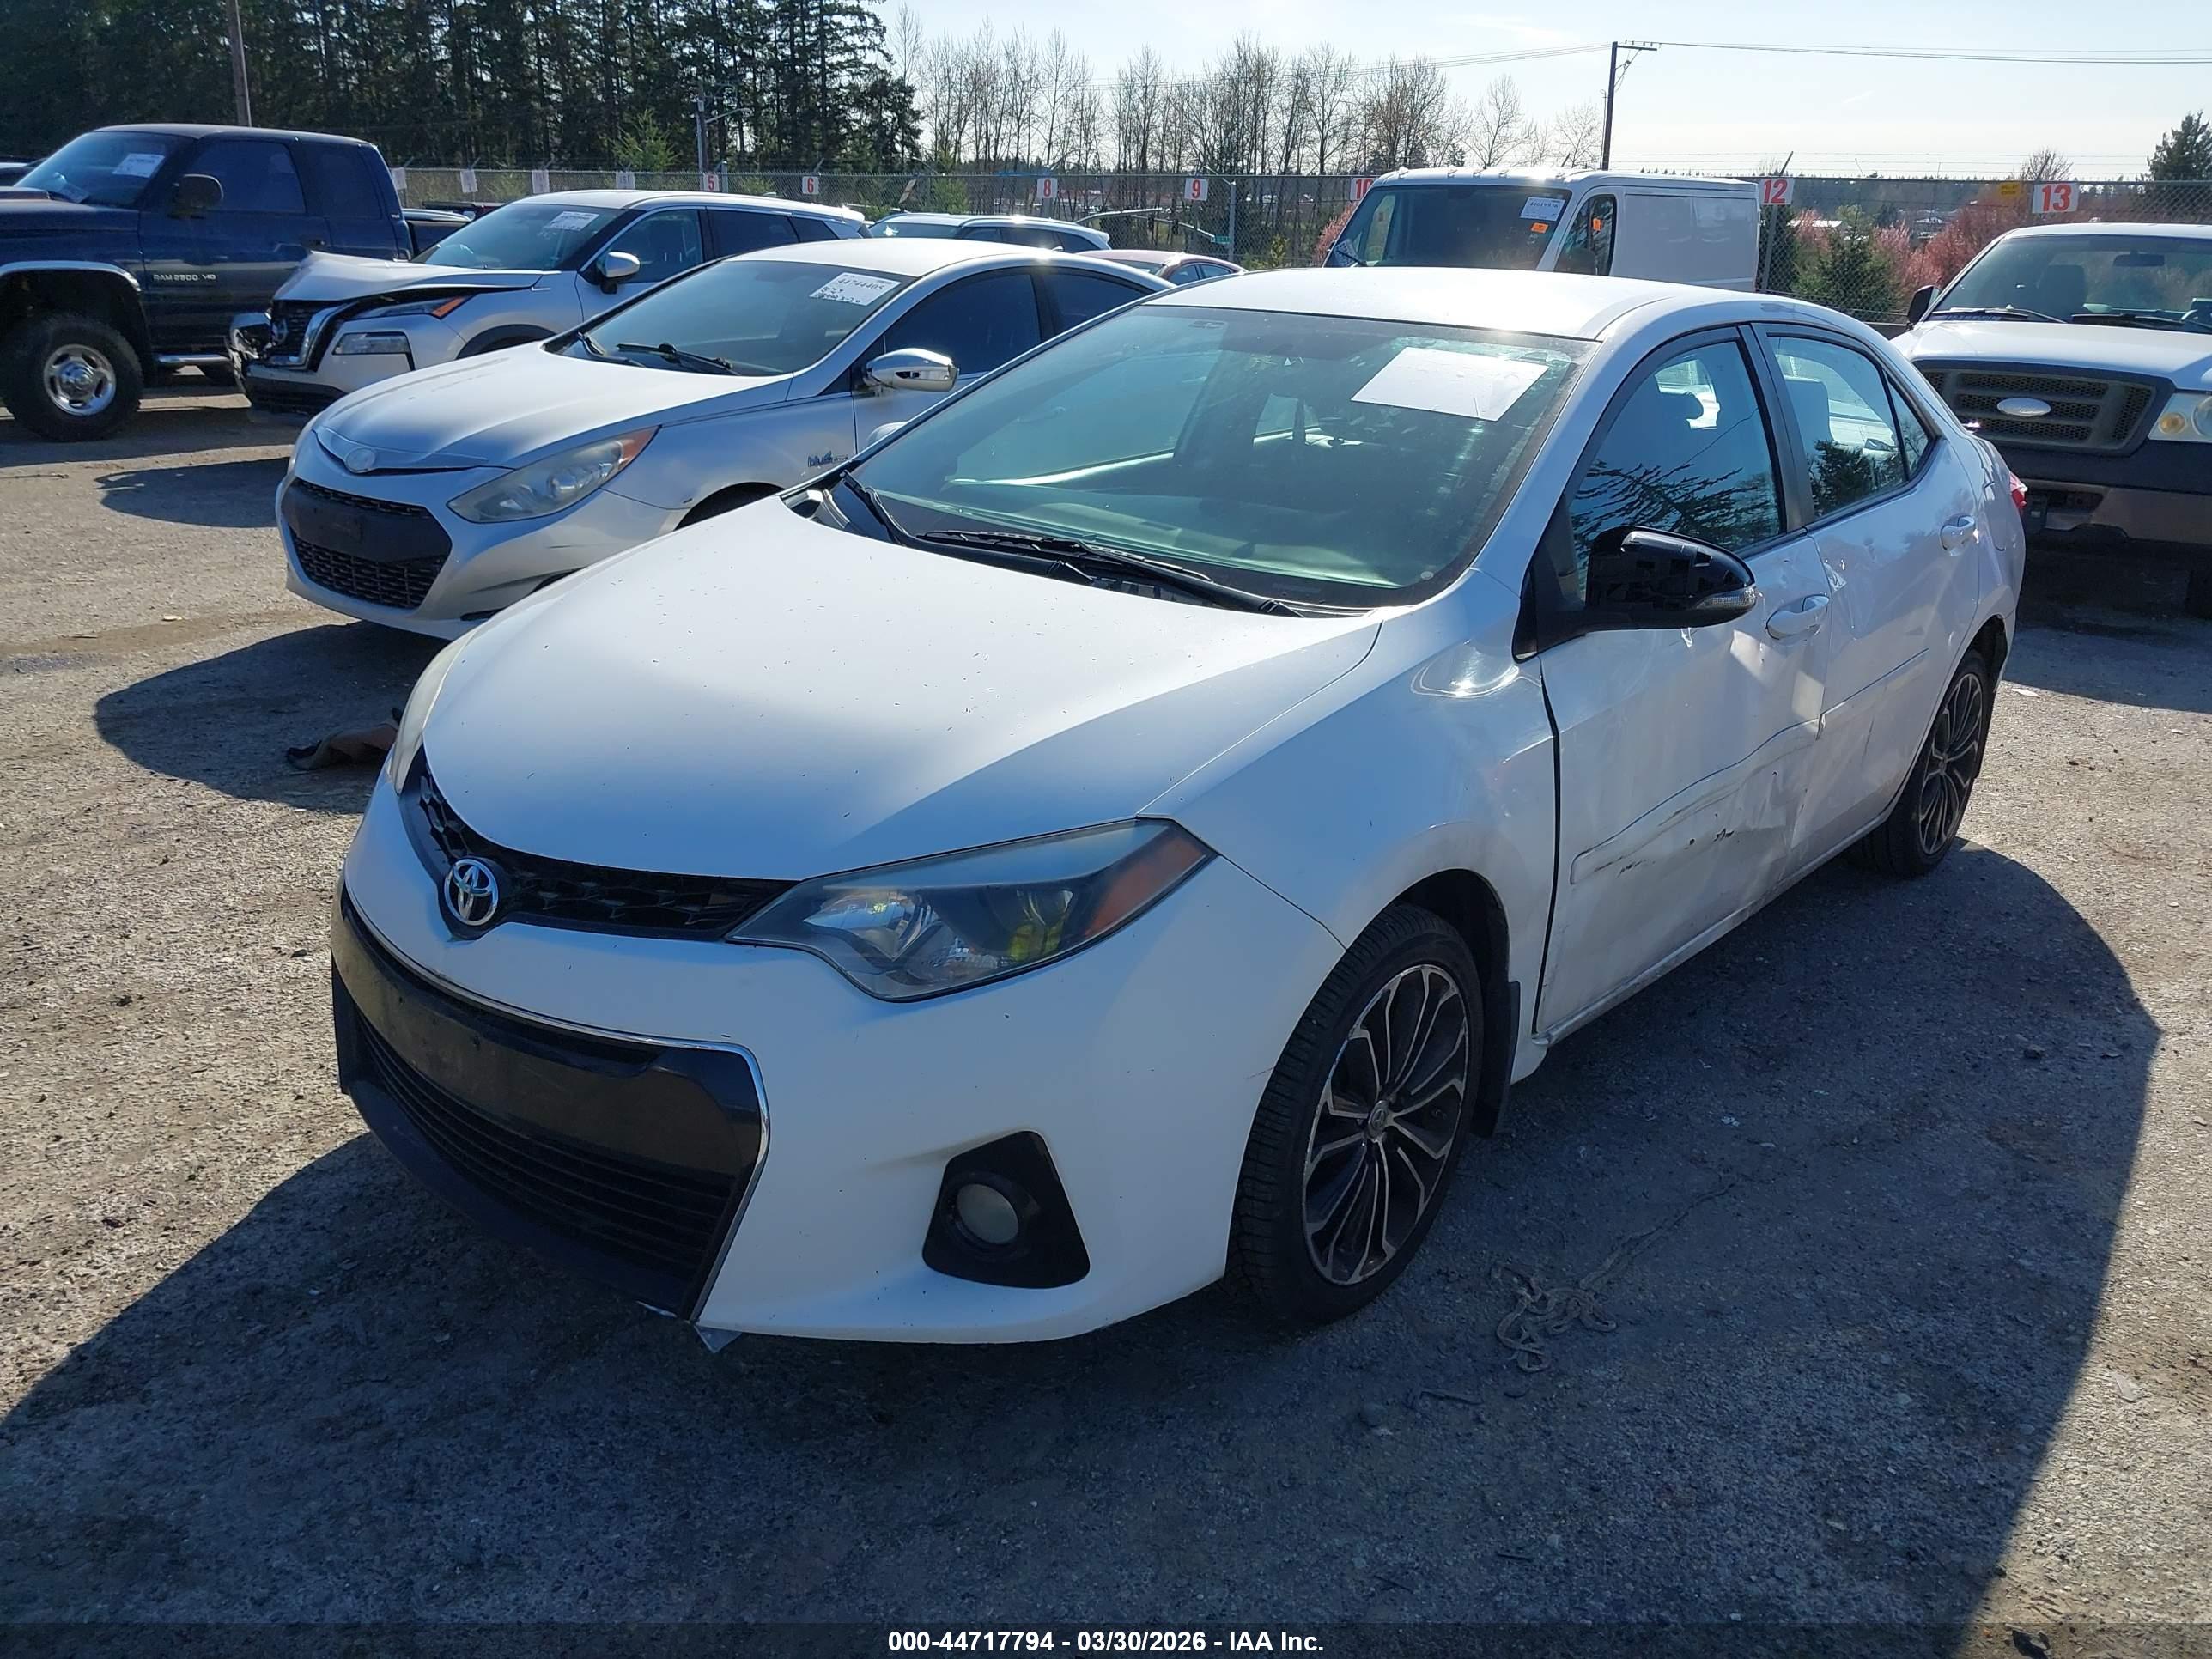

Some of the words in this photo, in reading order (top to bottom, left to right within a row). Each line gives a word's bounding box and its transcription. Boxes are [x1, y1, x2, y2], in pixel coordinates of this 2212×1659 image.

[708, 175, 714, 191] 5
[807, 178, 814, 193] 6
[1043, 179, 1052, 197] 8
[1192, 179, 1201, 198] 9
[1764, 179, 1788, 204] 12
[2041, 184, 2072, 212] 13
